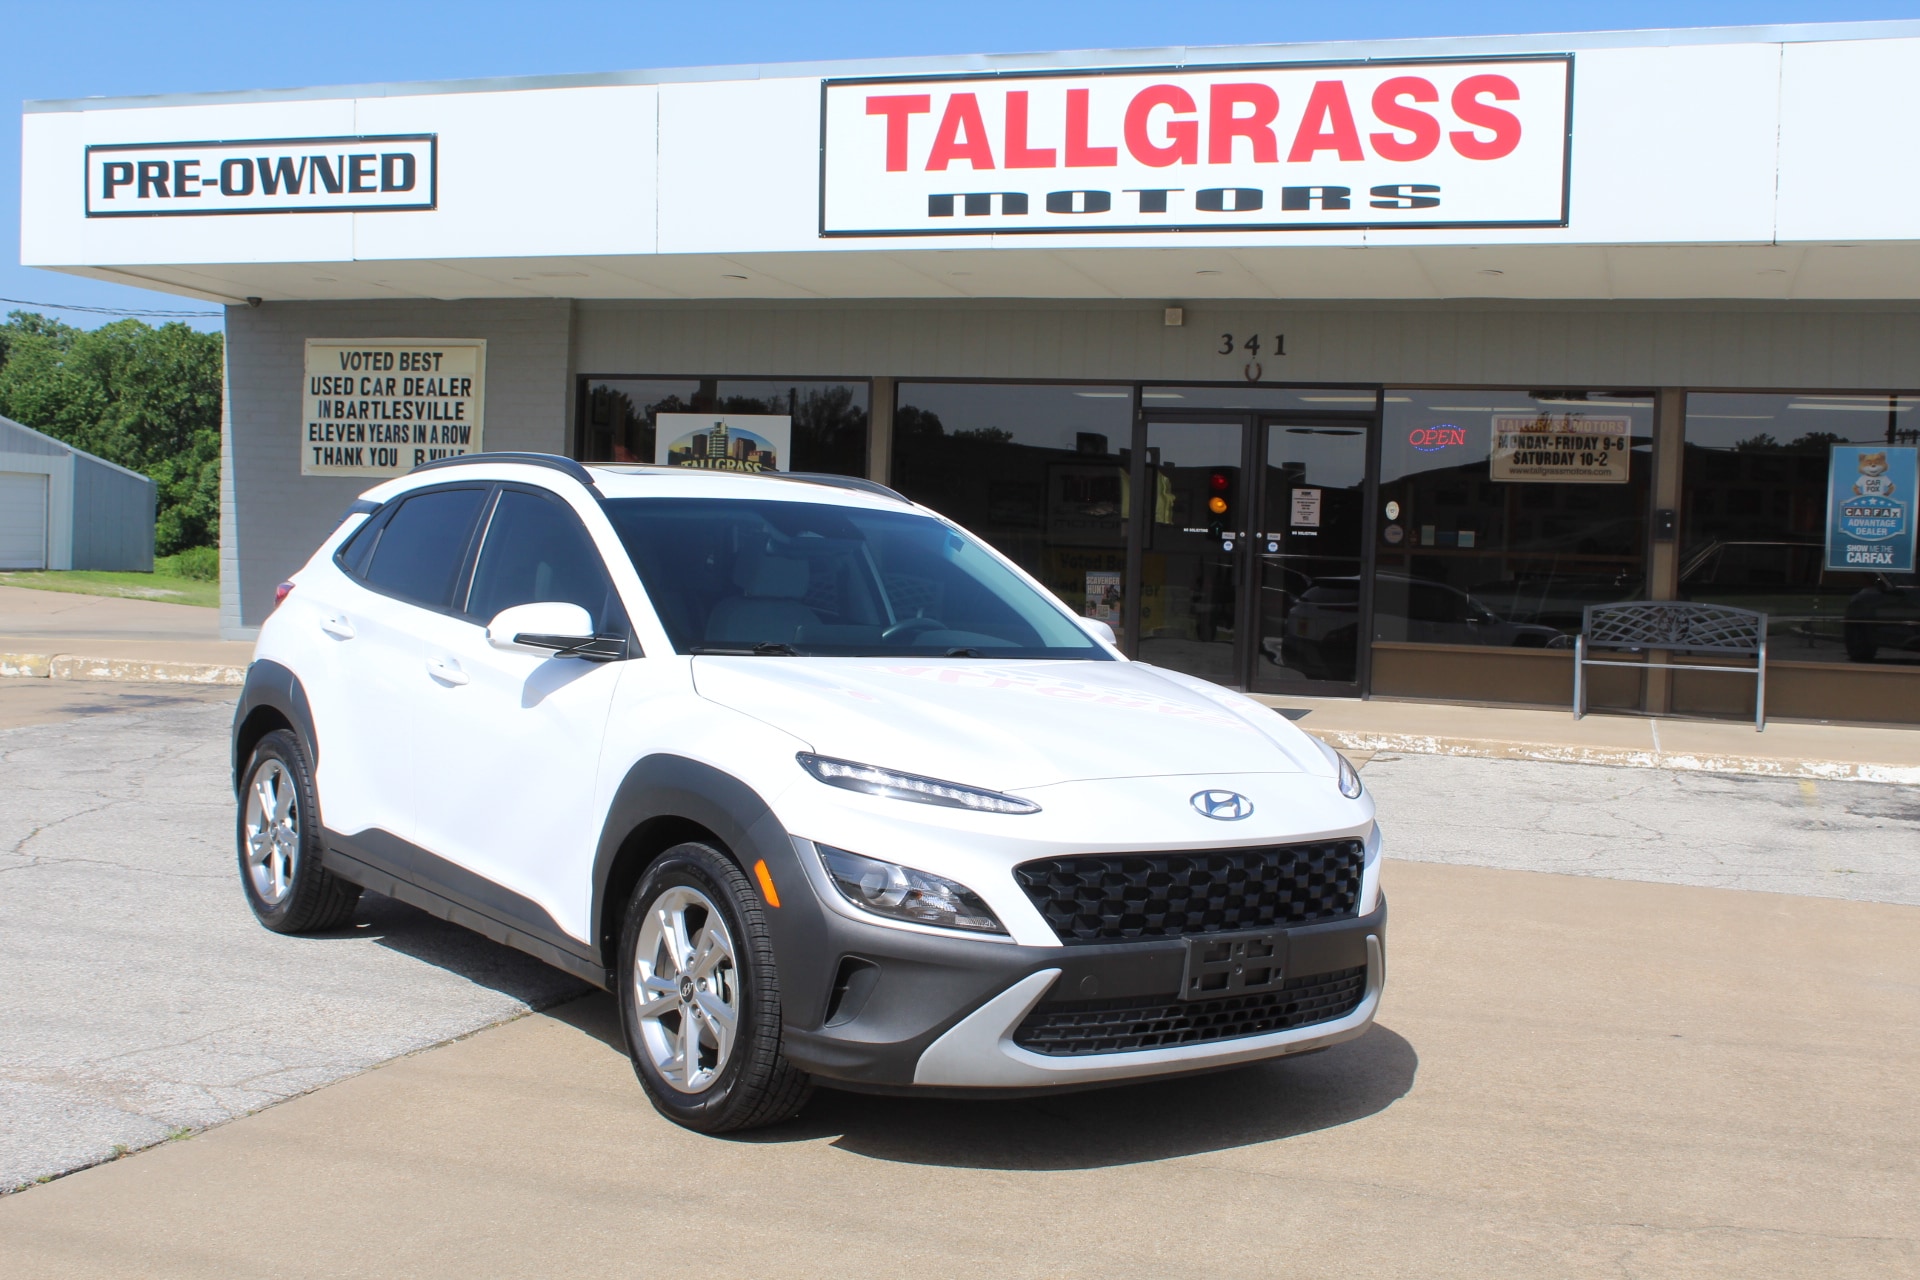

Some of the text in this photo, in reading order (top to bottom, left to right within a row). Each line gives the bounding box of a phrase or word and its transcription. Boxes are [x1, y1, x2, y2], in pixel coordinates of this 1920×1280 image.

[866, 74, 1522, 172] TALLGRASS
[102, 152, 416, 199] PRE-OWNED
[928, 184, 1441, 218] MOTORS
[1218, 333, 1286, 356] 341
[340, 351, 443, 372] VOTED BEST
[311, 377, 472, 397] USED CAR DEALER
[334, 401, 465, 420] BARTLESVILLE
[309, 423, 471, 444] ELEVEN YEARS IN A ROW
[1500, 420, 1625, 434] TALLGRASS MOTORS
[1409, 429, 1466, 446] OPEN
[1498, 435, 1625, 451] MONDAY-FRIDAY 9-6
[313, 447, 363, 466] THANK
[370, 448, 398, 467] YOU
[414, 449, 425, 467] B
[1513, 452, 1608, 467] SATURDAY 10-2
[1509, 467, 1612, 477] www.tallgrassmotors.com
[1845, 507, 1900, 518] CARFAX
[1848, 518, 1896, 527] ADVANTAGE
[1856, 528, 1888, 536] DEALER
[1847, 552, 1894, 564] CARFAX
[1086, 576, 1120, 585] SCAVENGER
[1087, 585, 1105, 594] HUNT
